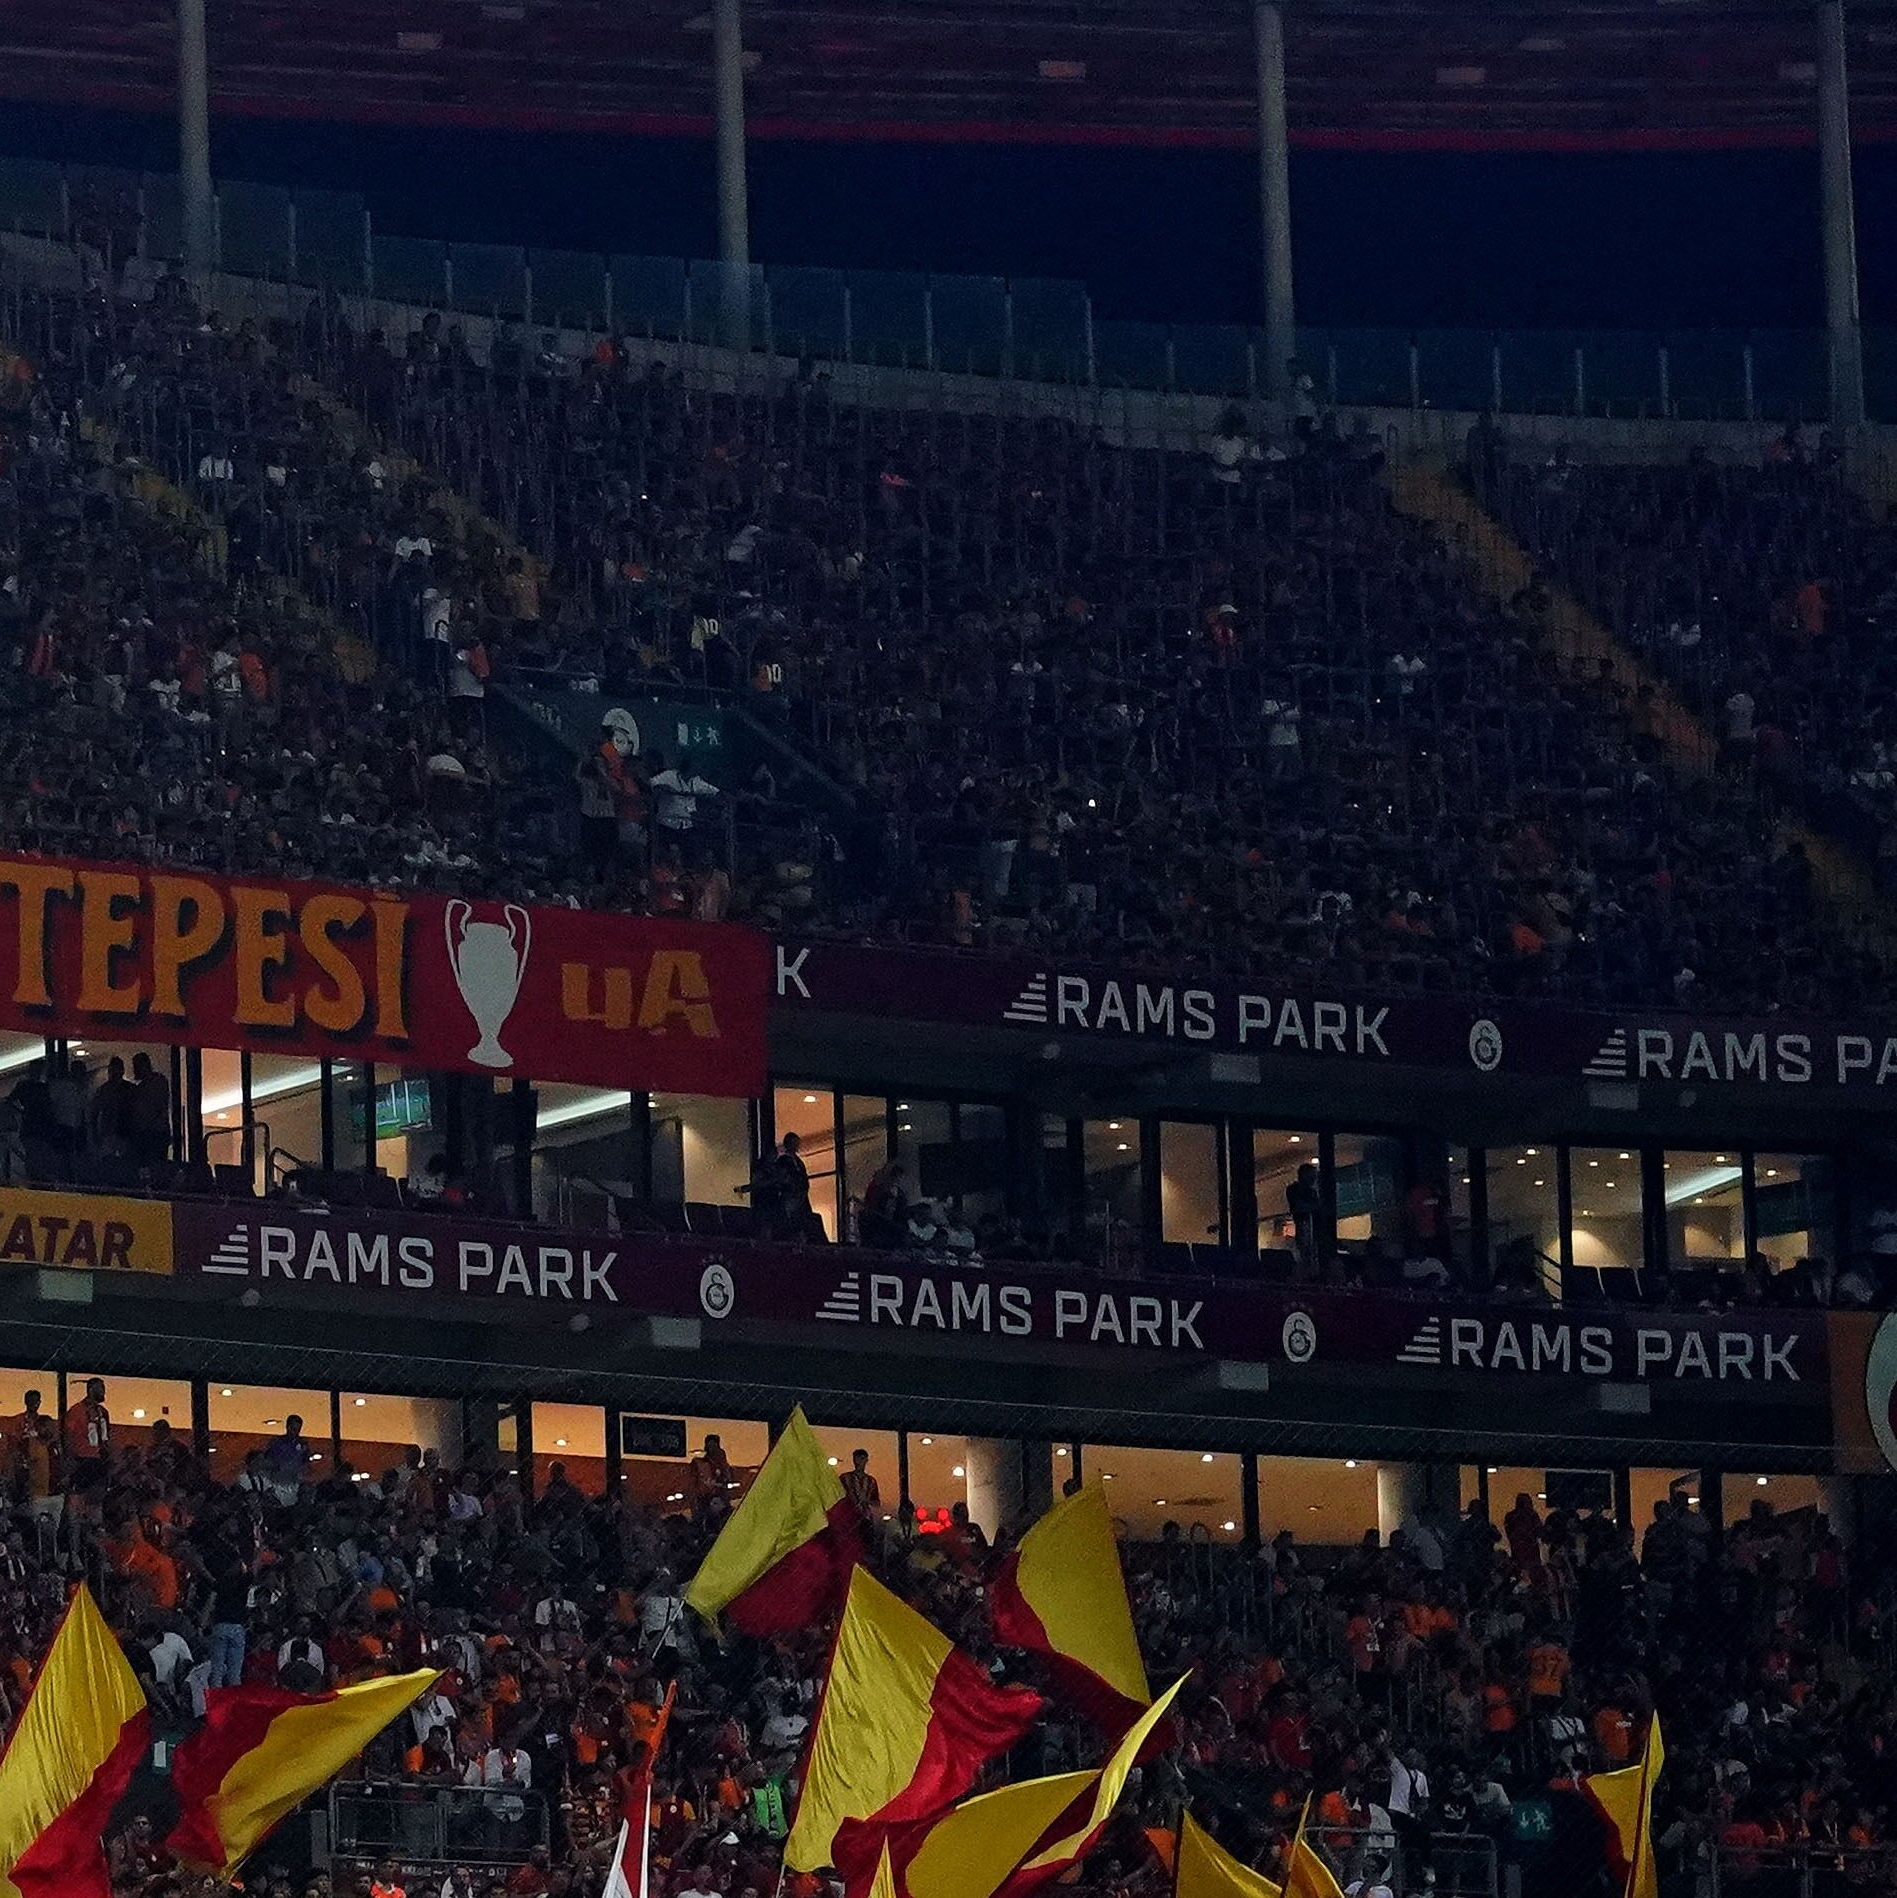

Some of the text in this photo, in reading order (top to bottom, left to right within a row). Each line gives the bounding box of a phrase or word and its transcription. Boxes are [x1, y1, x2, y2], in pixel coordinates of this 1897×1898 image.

[1057, 975, 1390, 1056] RAMS PARK
[1637, 1029, 1812, 1083] RAMS
[260, 1225, 619, 1302] RAMS PARK
[870, 1273, 1204, 1349] RAMS PARK
[1450, 1317, 1801, 1381] RAMS PARK
